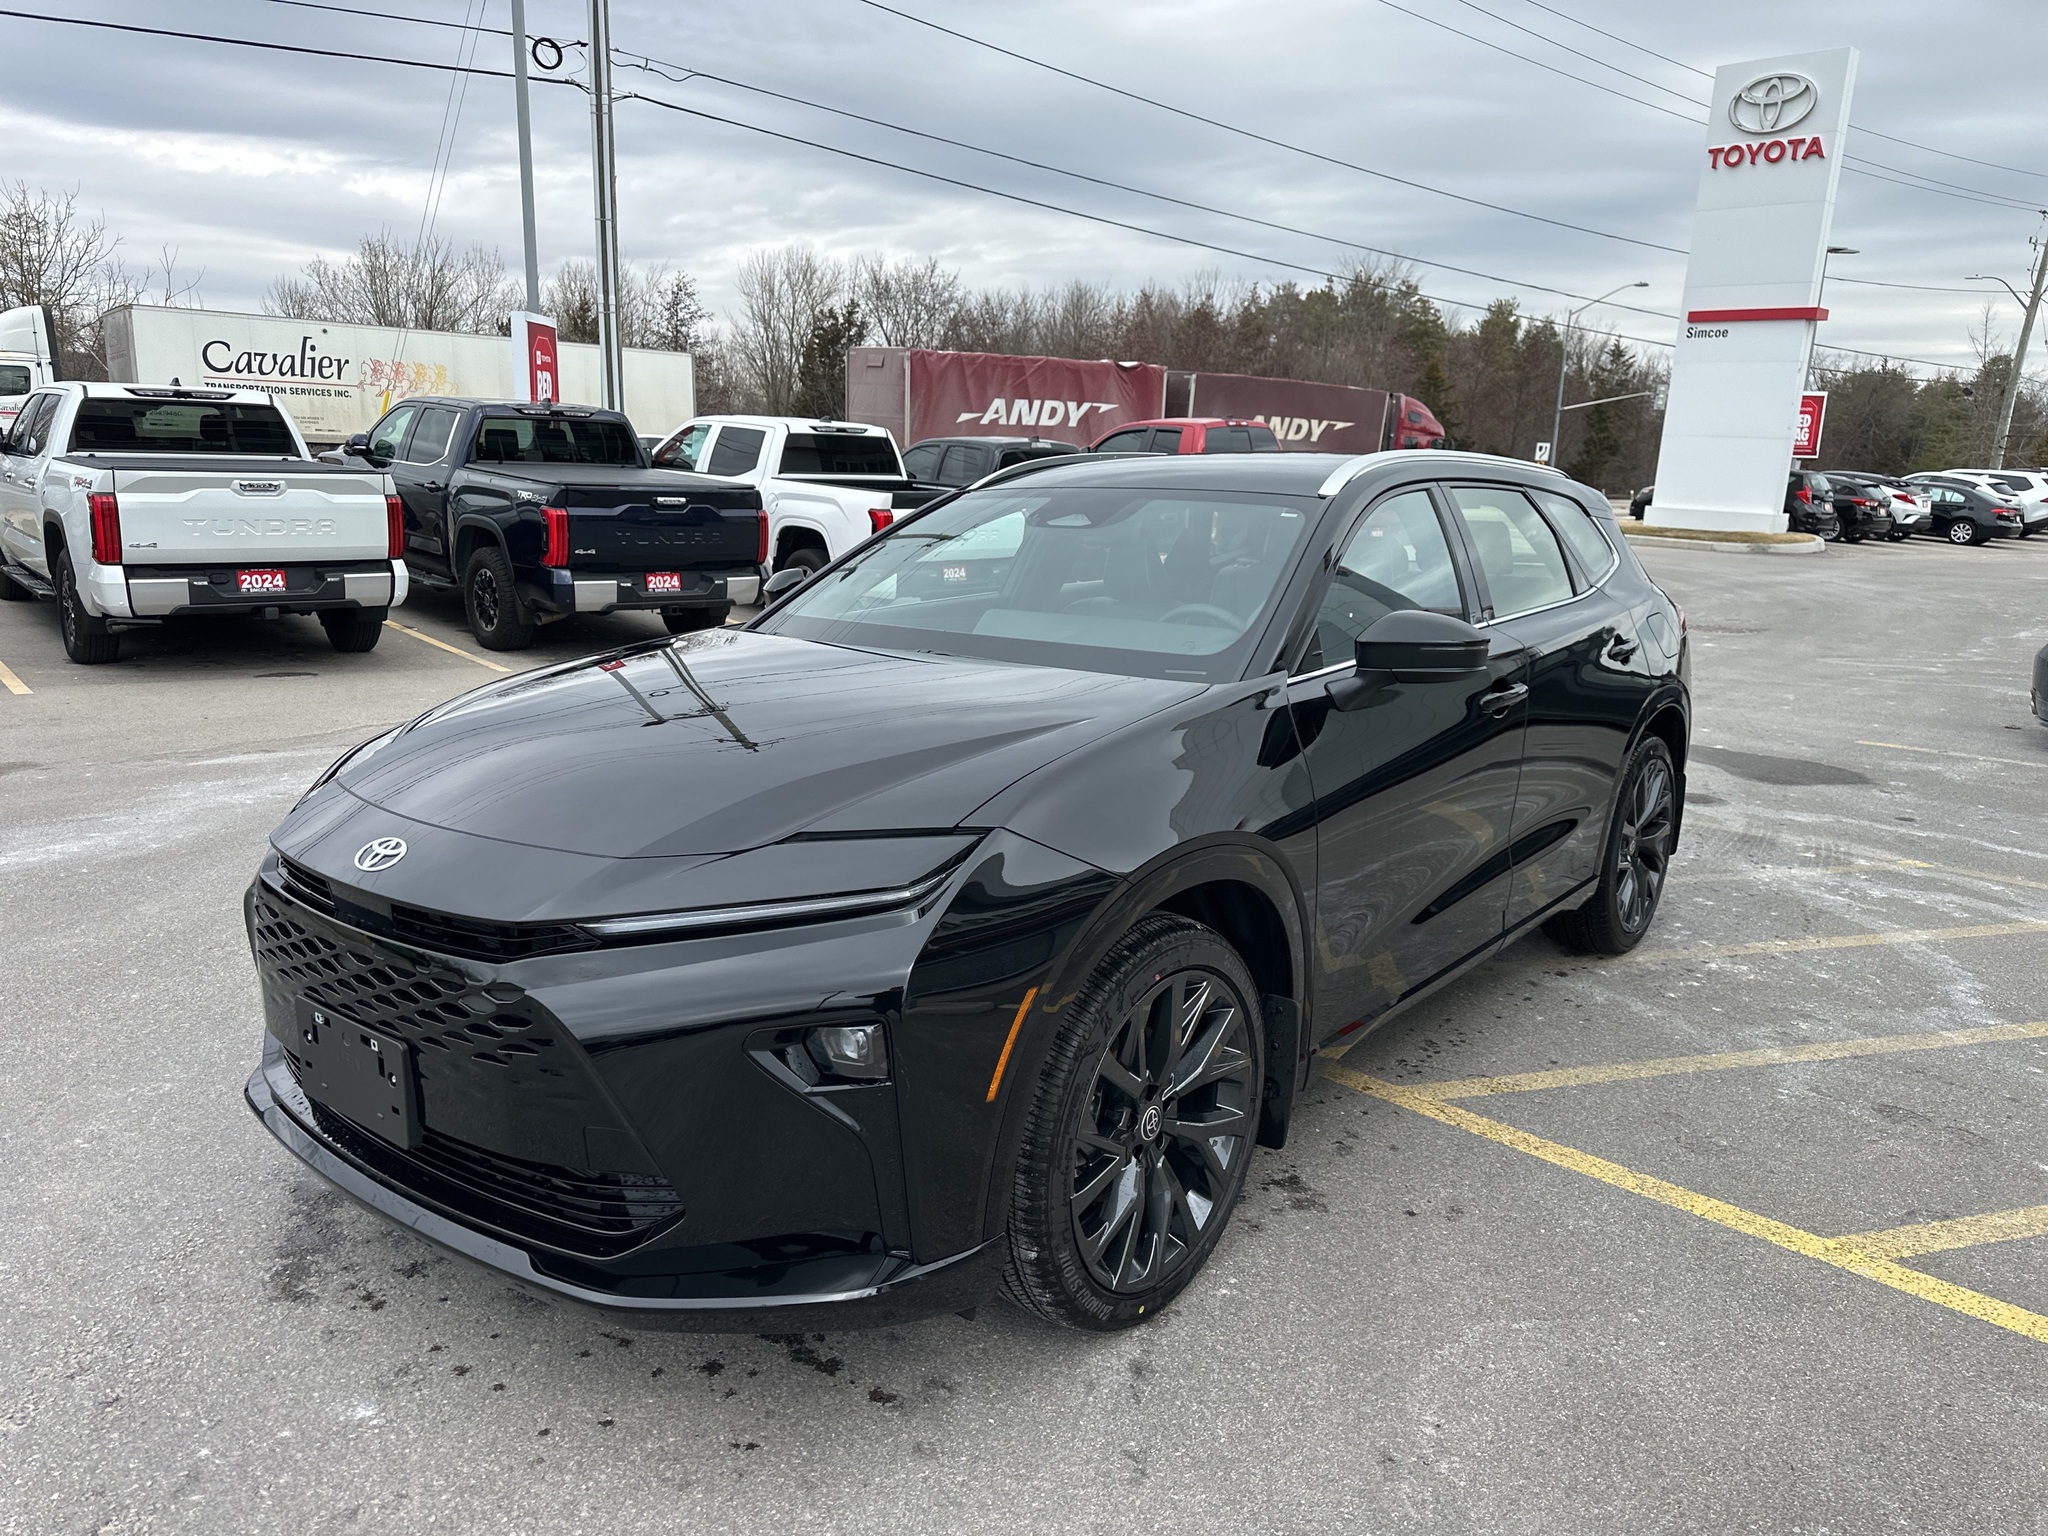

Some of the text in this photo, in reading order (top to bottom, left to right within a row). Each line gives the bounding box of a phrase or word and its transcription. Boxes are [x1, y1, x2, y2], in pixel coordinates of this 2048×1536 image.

[1708, 137, 1825, 169] TOYOTA
[1686, 326, 1729, 339] Simcoe
[202, 336, 350, 380] Cavalier
[289, 387, 333, 397] SERVICES
[334, 389, 352, 399] INC.
[537, 370, 553, 402] RED
[979, 397, 1092, 427] ANDY
[182, 518, 337, 536] TUNDRA
[615, 530, 724, 545] TUNDRA
[943, 567, 966, 578] 2024
[241, 573, 284, 588] 2024
[648, 575, 679, 588] 2024
